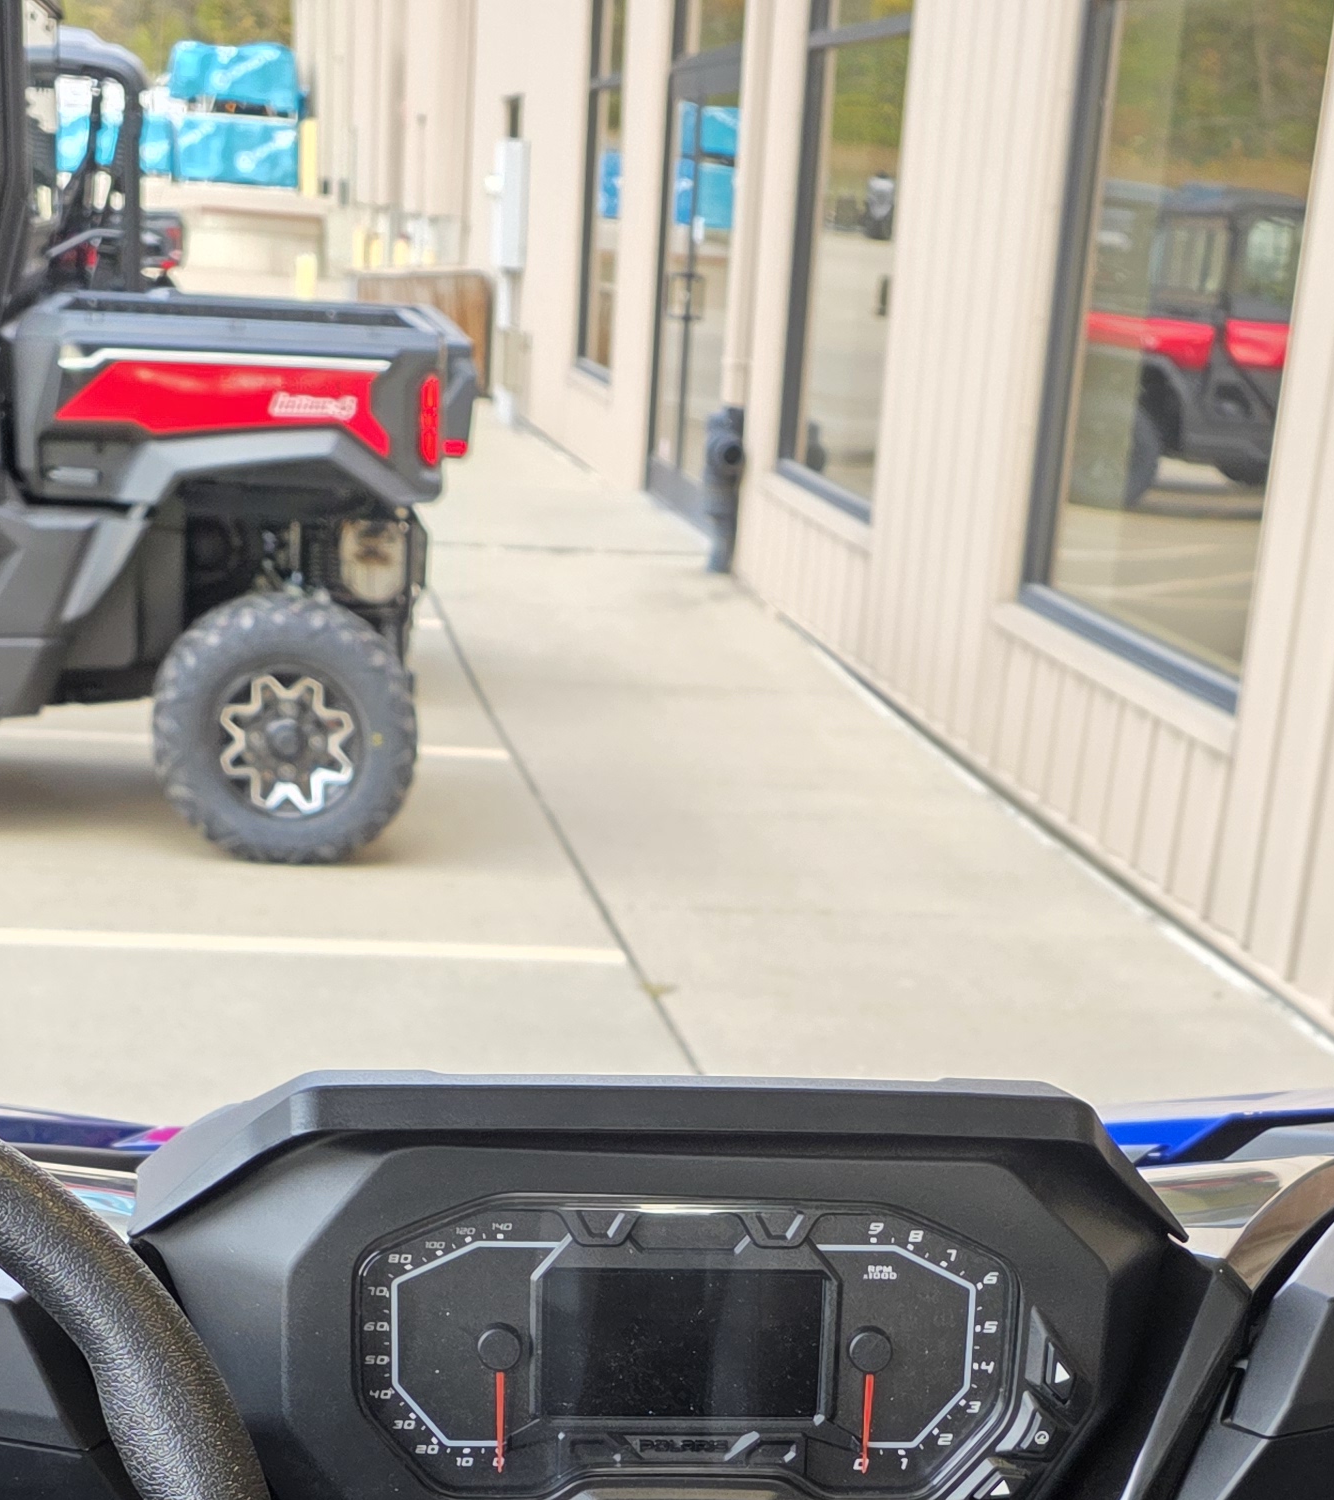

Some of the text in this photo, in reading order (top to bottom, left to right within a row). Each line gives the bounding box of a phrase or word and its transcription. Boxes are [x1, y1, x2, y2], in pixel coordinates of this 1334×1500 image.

[455, 1227, 476, 1236] 120
[491, 1222, 513, 1231] 140
[868, 1222, 884, 1235] 9
[908, 1230, 924, 1243] 8
[425, 1241, 446, 1249] 100
[388, 1254, 412, 1264] 80
[946, 1249, 957, 1262] 7
[867, 1265, 893, 1273] RPM
[982, 1272, 999, 1285] 6
[367, 1286, 388, 1297] 70
[363, 1321, 389, 1332] 60
[982, 1320, 998, 1334] 5
[364, 1355, 389, 1365] 50
[980, 1361, 995, 1374] 4
[369, 1389, 392, 1399] 40
[966, 1401, 982, 1414] 3
[392, 1419, 416, 1430] 30
[937, 1433, 954, 1446] 2
[415, 1444, 439, 1455] 20
[639, 1439, 728, 1453] POLARIS
[455, 1457, 473, 1467] 10
[492, 1456, 505, 1467] 0
[853, 1458, 870, 1471] 0
[900, 1458, 909, 1470] 1
